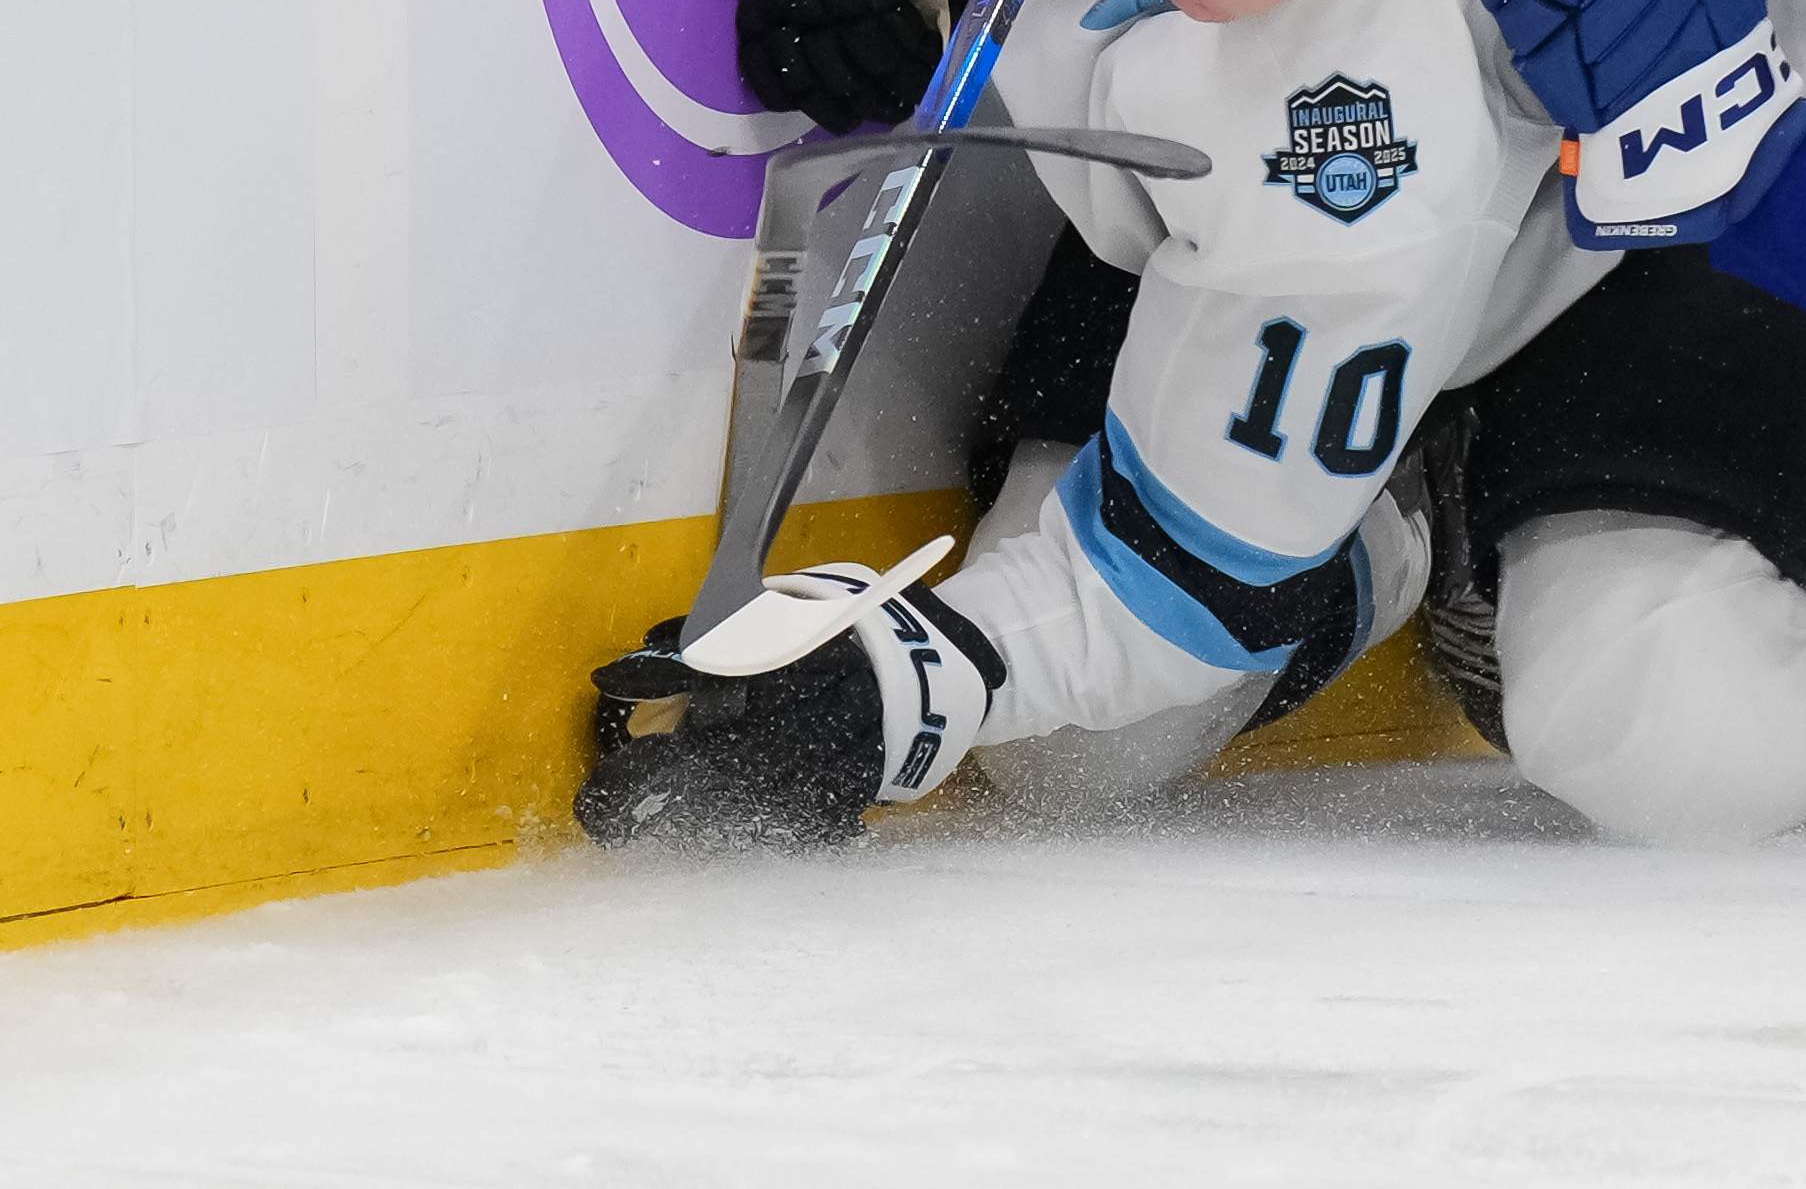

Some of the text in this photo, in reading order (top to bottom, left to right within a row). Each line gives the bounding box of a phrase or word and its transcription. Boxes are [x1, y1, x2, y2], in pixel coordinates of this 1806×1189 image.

[1292, 101, 1389, 128] INAUGURAL
[1619, 32, 1791, 179] CM
[1293, 120, 1391, 154] SEASON
[1280, 146, 1407, 171] 2024 2025
[1325, 172, 1368, 193] UTAH
[1224, 315, 1413, 478] 10
